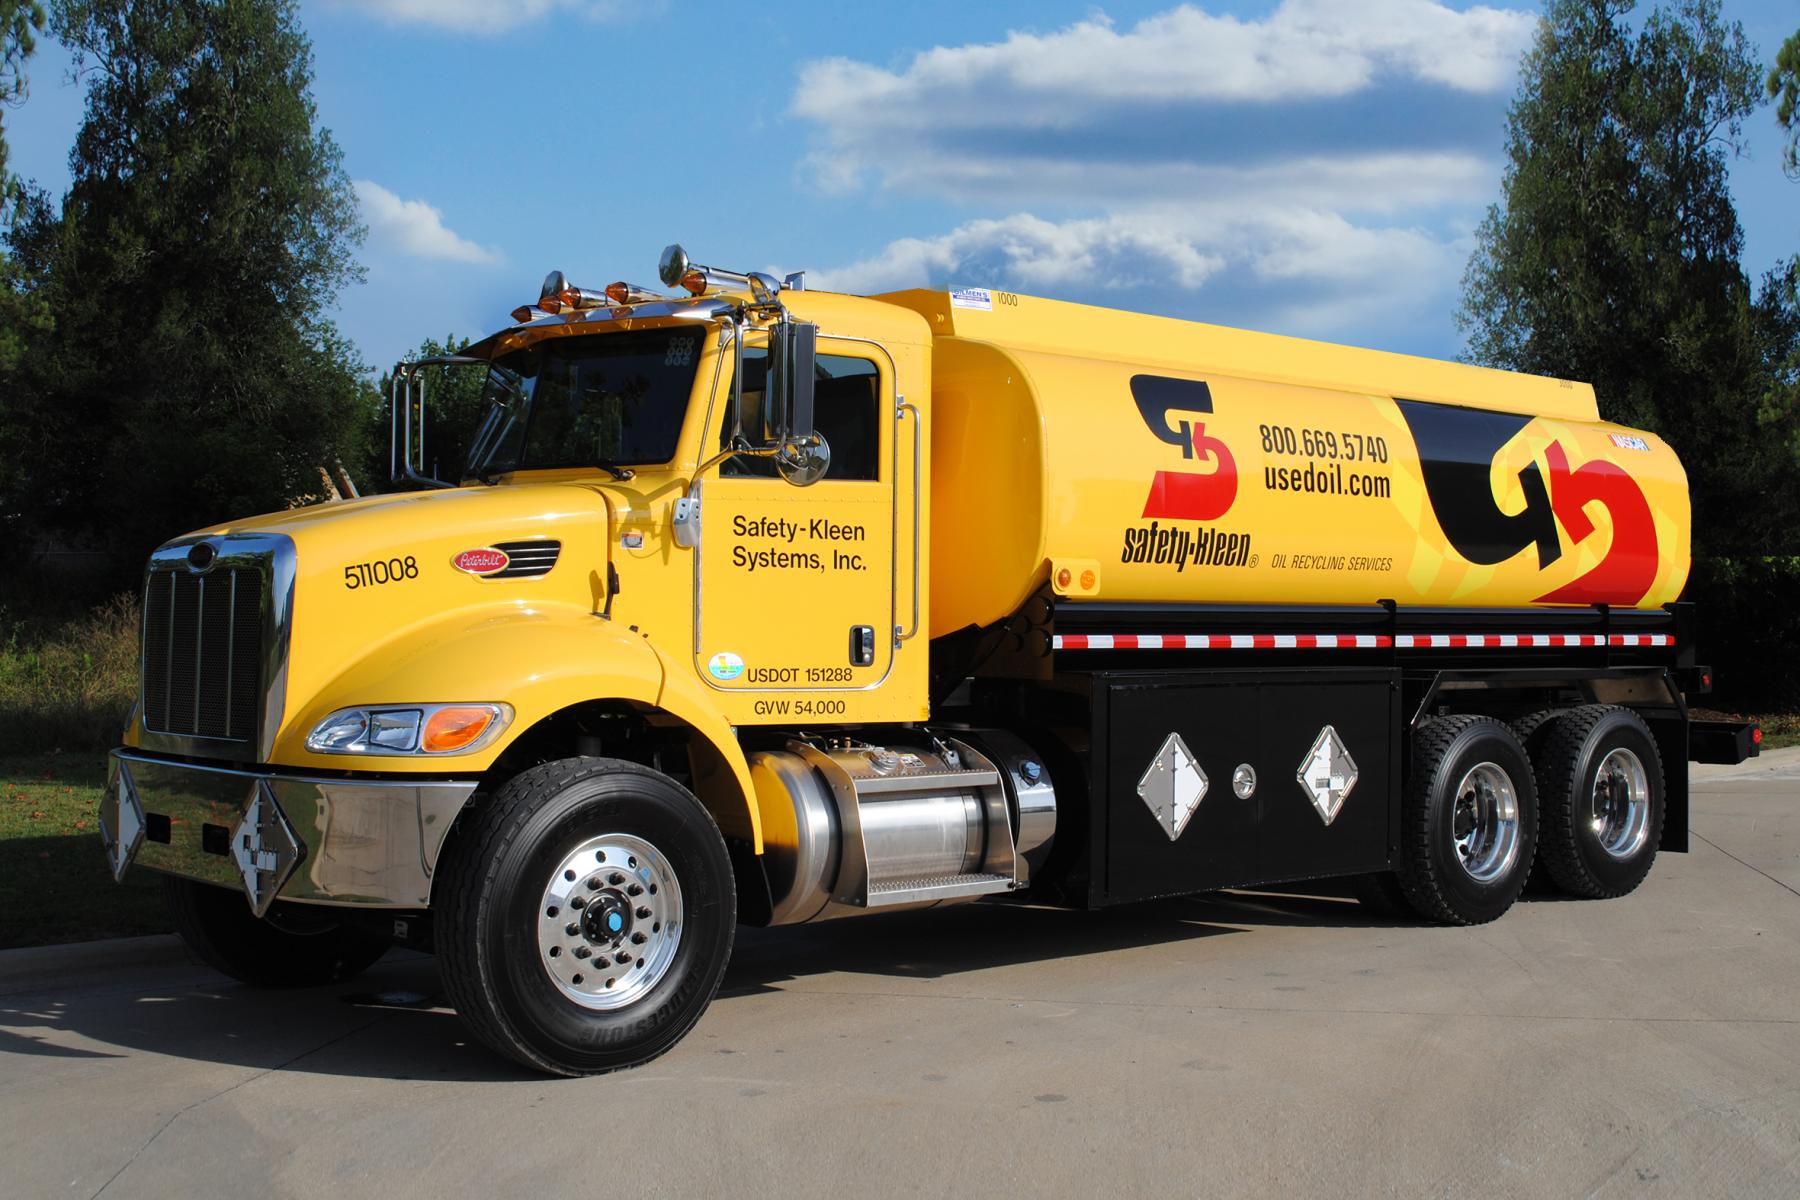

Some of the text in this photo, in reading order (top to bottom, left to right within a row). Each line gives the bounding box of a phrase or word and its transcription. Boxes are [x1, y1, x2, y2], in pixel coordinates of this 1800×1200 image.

[997, 292, 1018, 307] 1000
[1259, 424, 1388, 464] 800.669.5740
[1265, 461, 1390, 498] usedoil.com
[733, 515, 865, 542] Safety-Kleen
[460, 553, 503, 568] Peterbilt
[733, 546, 867, 573] Systems, Inc.
[1271, 553, 1393, 571] OIL RECYCLING SERVICES
[345, 555, 419, 589] 511008
[747, 668, 799, 683] USDOT
[805, 667, 853, 682] 151288
[754, 701, 846, 717] GVW 54,000
